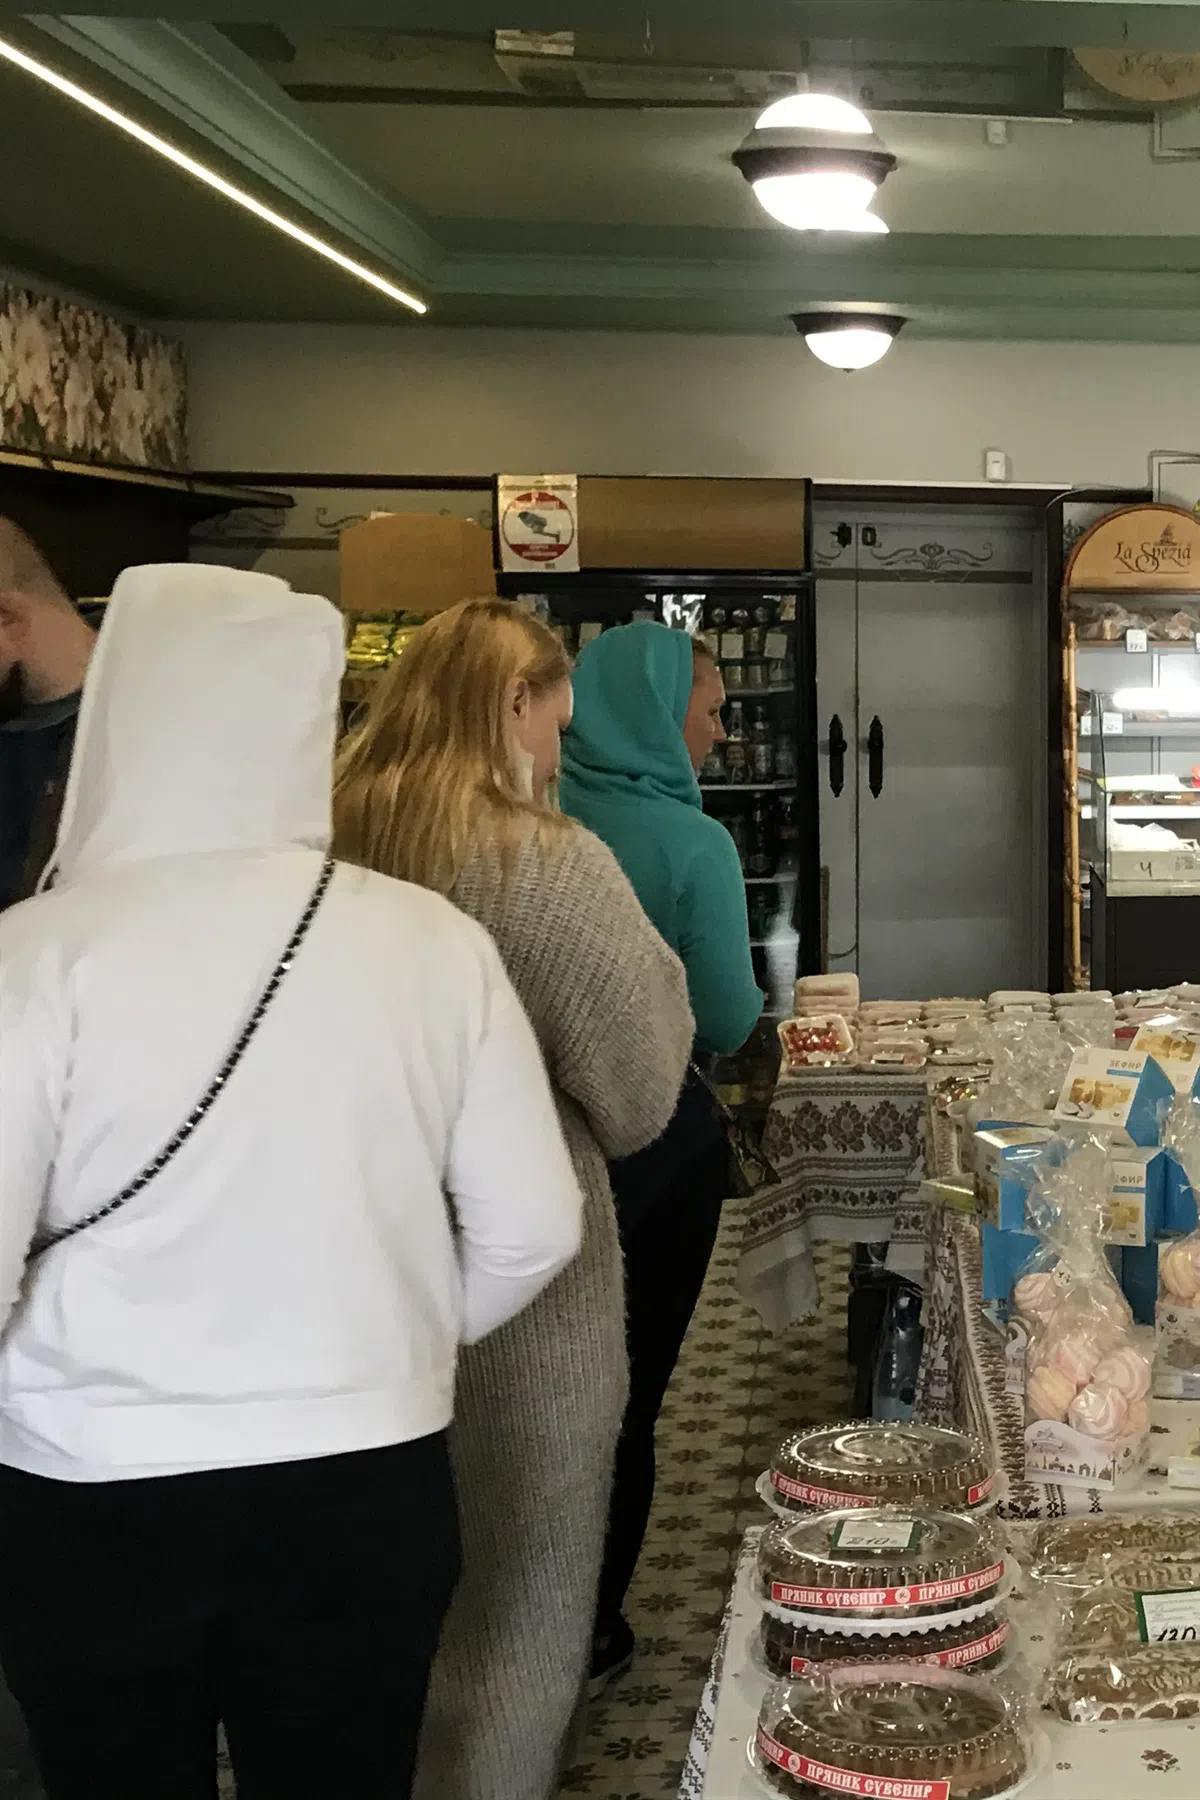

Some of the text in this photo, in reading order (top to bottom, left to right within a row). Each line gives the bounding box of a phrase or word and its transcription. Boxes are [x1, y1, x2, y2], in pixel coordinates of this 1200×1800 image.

[1135, 541, 1192, 573] Spezia
[1109, 1060, 1142, 1070] ЗЕФИР
[781, 1587, 824, 1604] ПРЯНИК
[825, 1591, 887, 1608] СУВЕНИР
[918, 1580, 966, 1601] ПРЯНИК
[947, 1640, 988, 1664] ПРЯНИК
[807, 1763, 861, 1791] ПРЯНИК
[864, 1779, 933, 1797] СУВЕНИР
